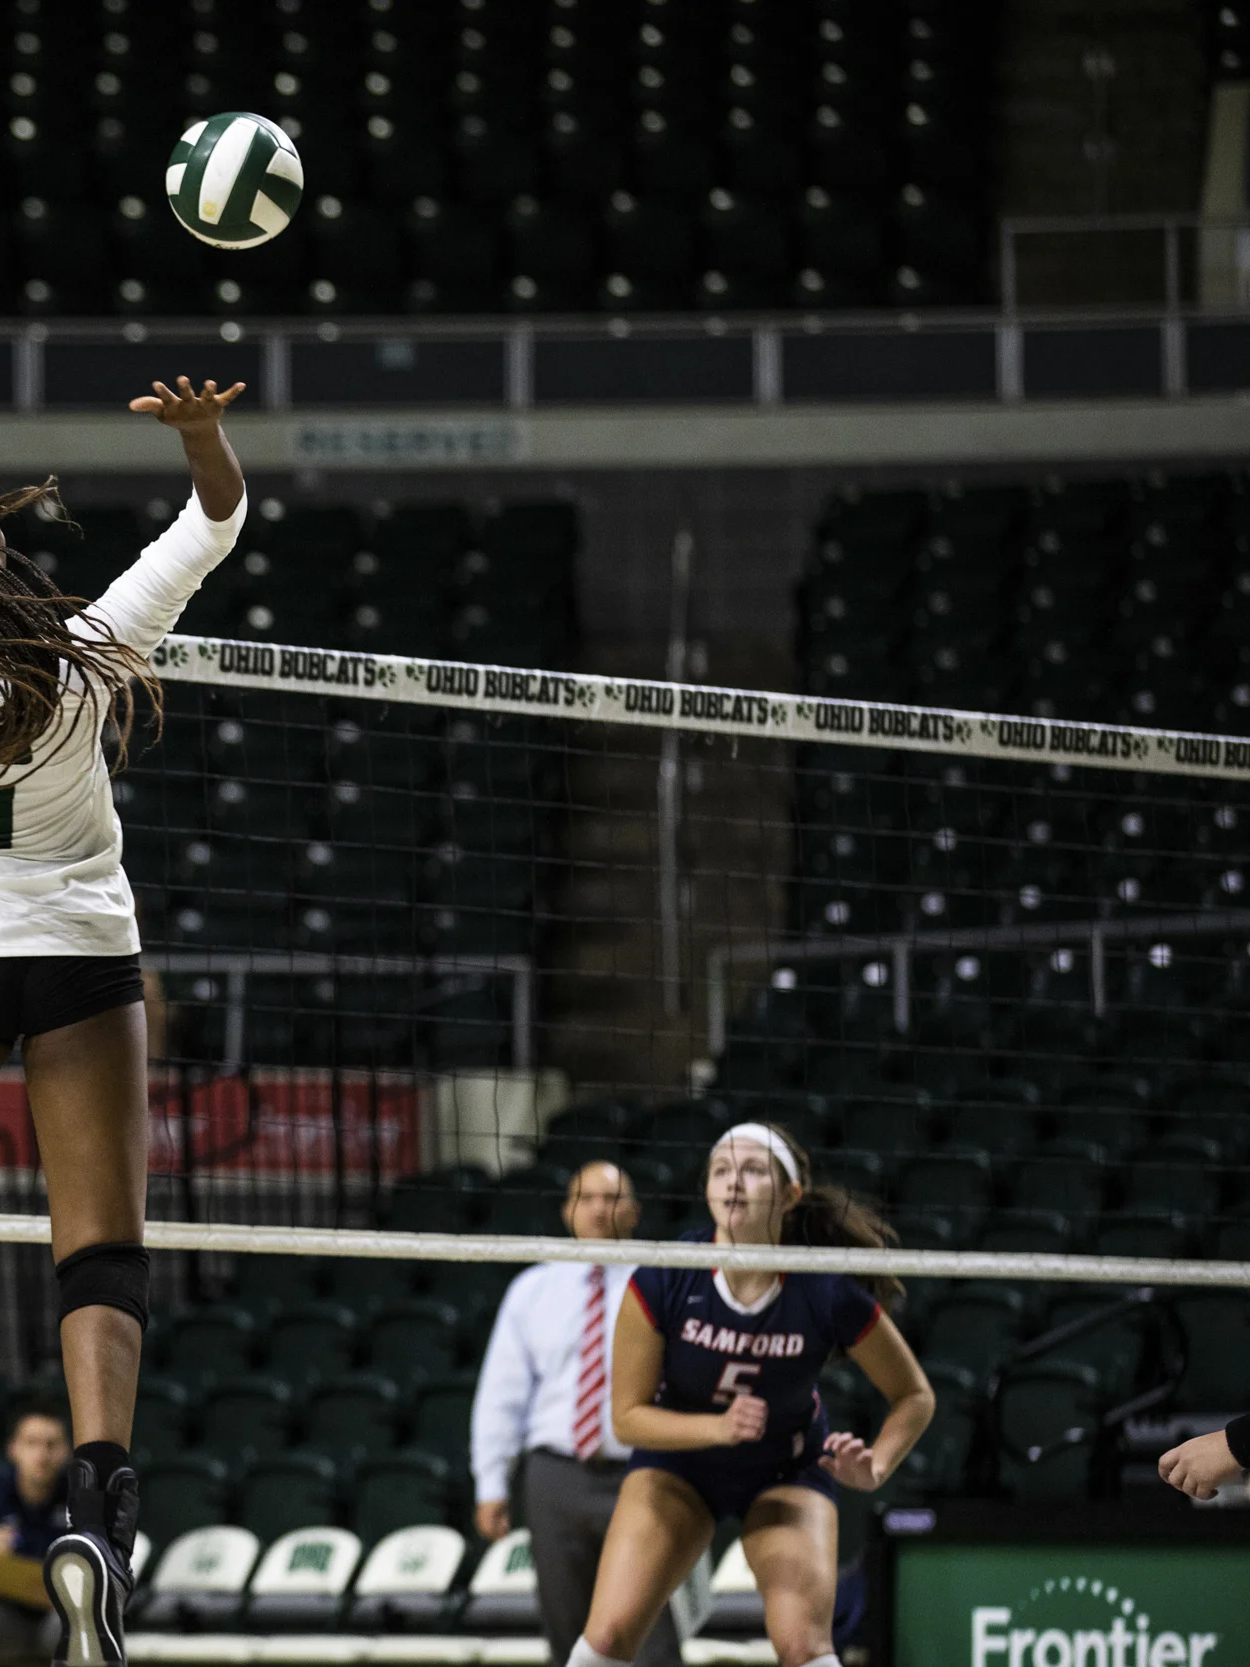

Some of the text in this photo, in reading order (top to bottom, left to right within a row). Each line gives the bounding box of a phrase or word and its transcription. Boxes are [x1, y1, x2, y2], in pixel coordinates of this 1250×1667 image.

[220, 642, 376, 685] OHIO BOBCATS
[427, 666, 577, 706] OHIO BOBCATS
[626, 686, 768, 725] OHIO BOBCATS
[815, 704, 955, 742] OHIO BOBCATS
[998, 720, 1132, 757] OHIO BOBCATS
[1175, 737, 1220, 763] OHIO
[680, 1317, 805, 1358] SAMFORD
[711, 1361, 762, 1406] 5
[970, 1606, 1219, 1667] Frontier
